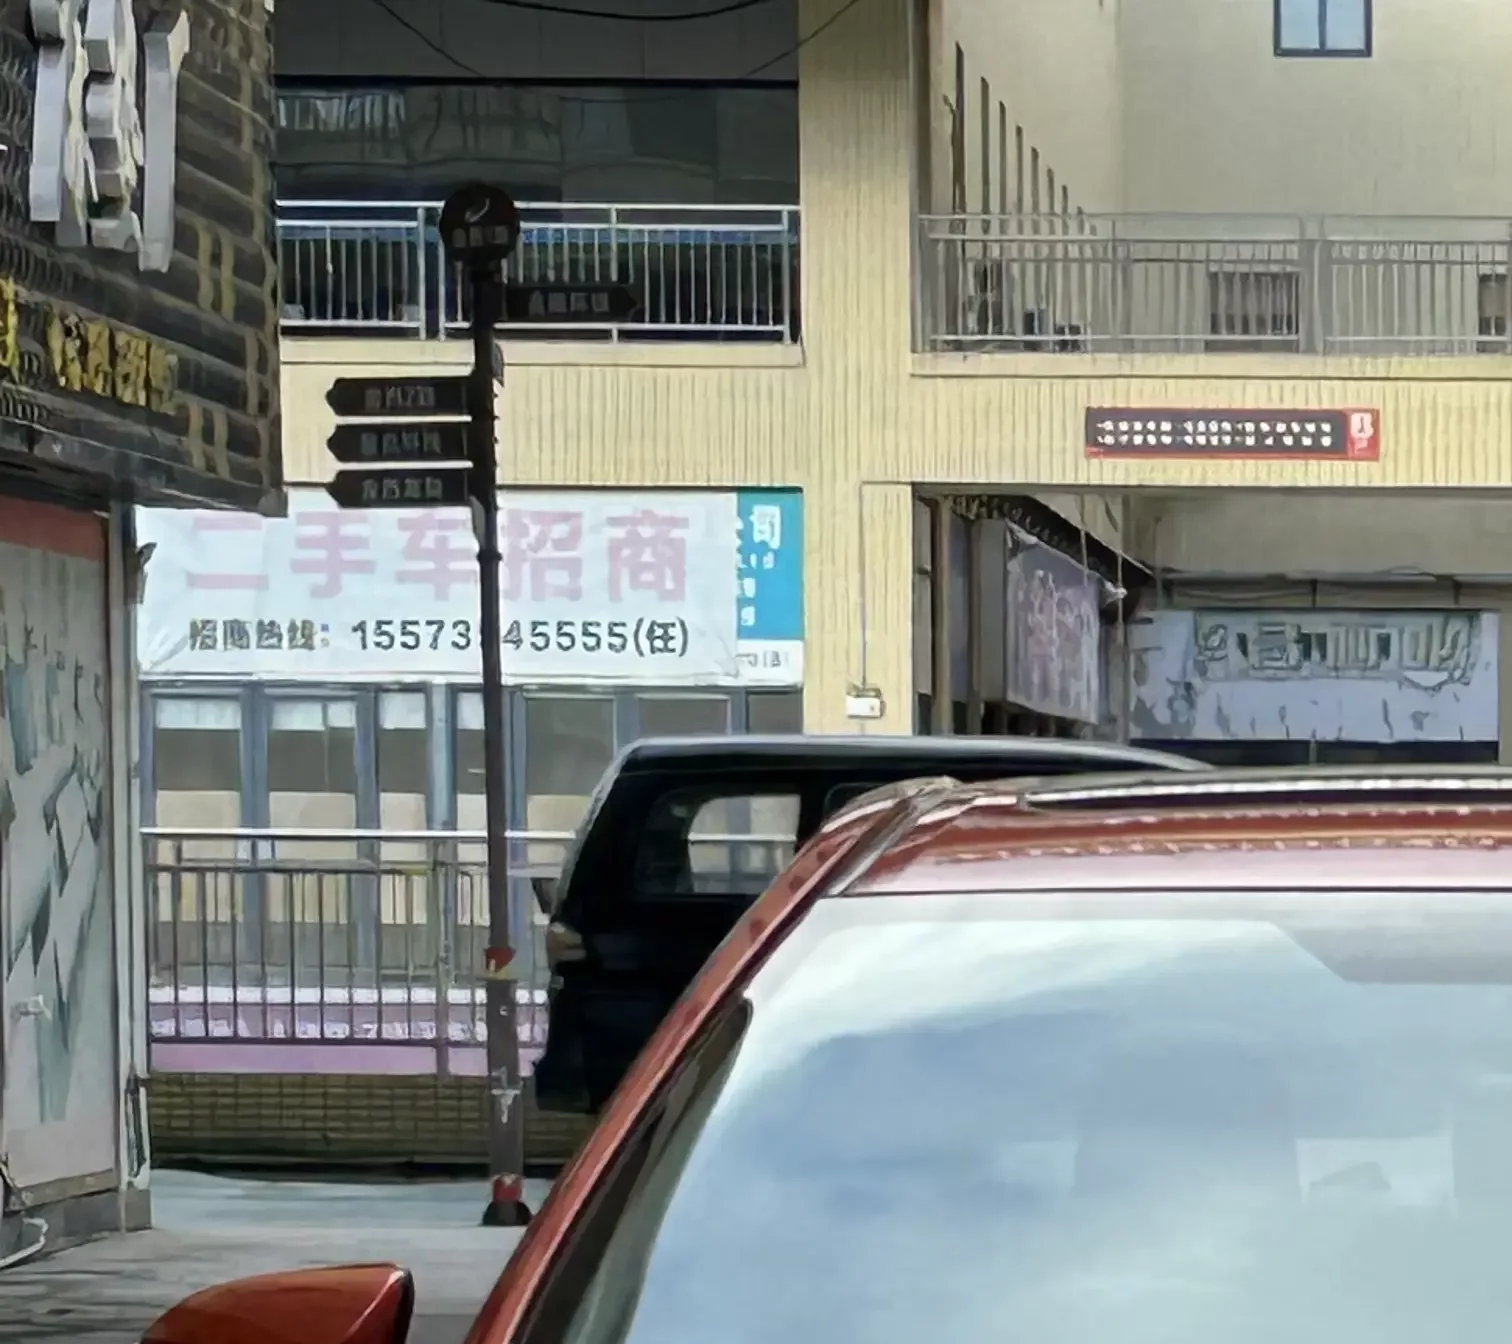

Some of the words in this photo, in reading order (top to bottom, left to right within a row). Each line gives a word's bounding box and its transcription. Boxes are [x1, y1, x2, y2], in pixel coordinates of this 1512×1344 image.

[186, 509, 689, 602] 二手车招商
[351, 616, 689, 657] 1557345555(任)
